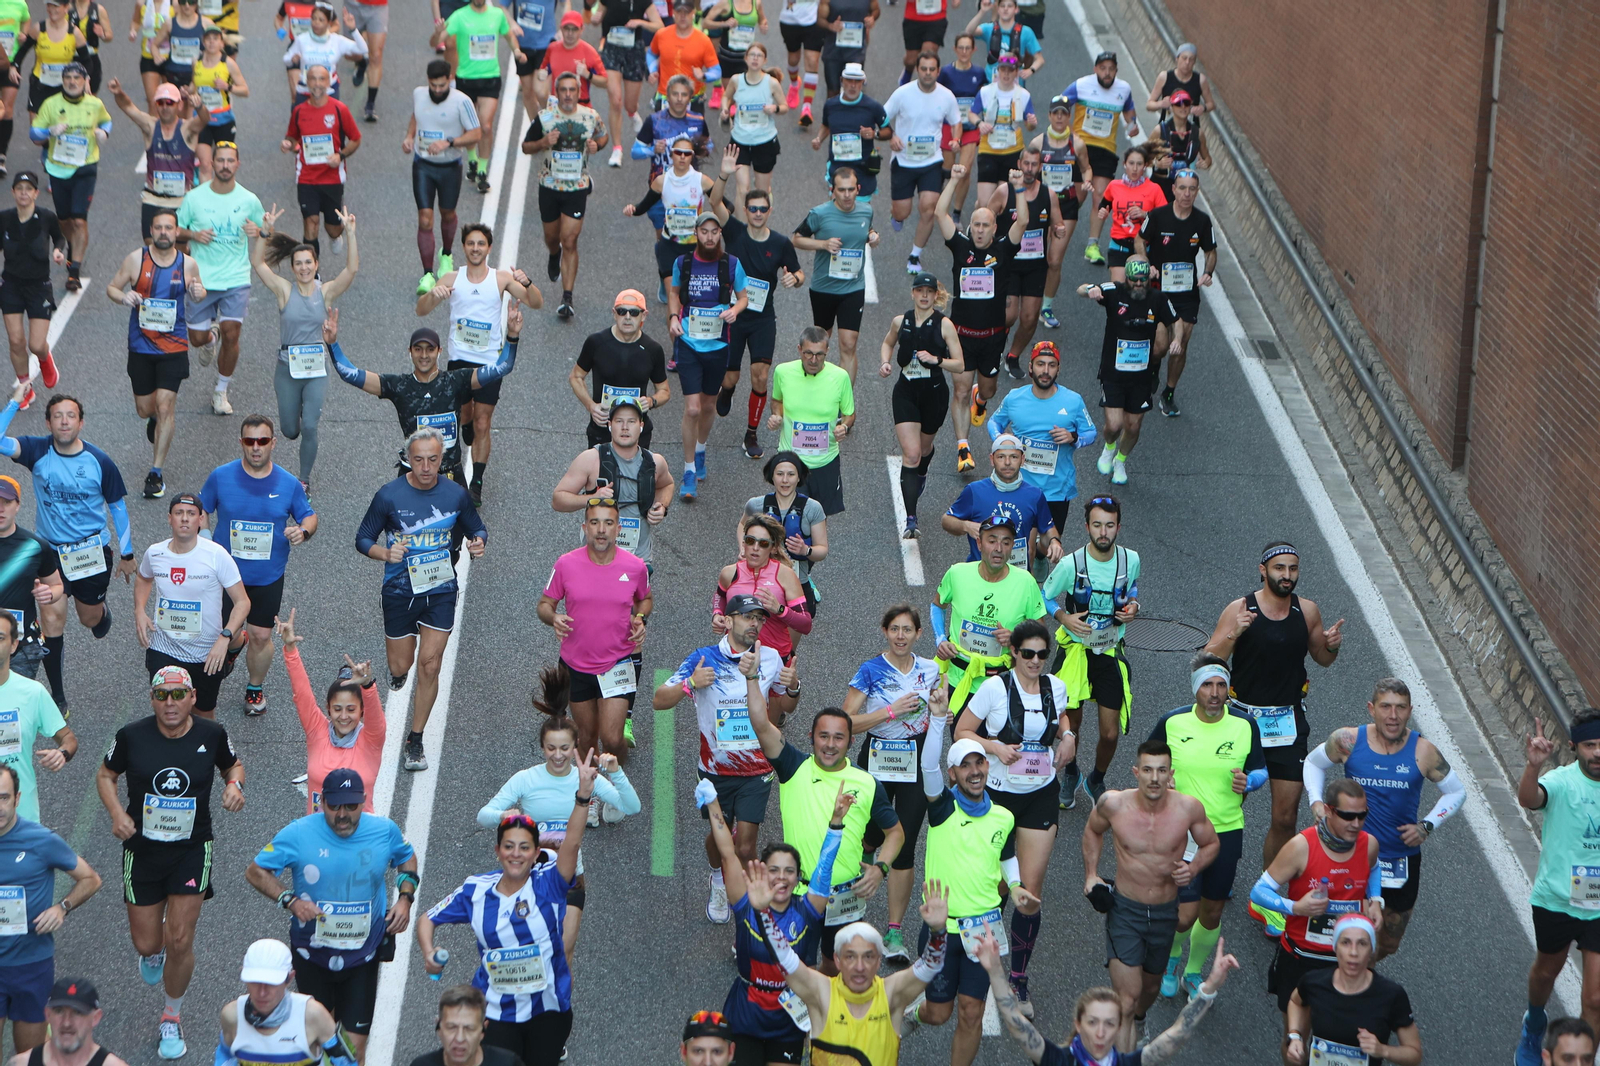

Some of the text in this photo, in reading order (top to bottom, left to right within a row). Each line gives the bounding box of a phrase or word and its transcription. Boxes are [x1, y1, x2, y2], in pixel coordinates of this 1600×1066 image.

[468, 320, 489, 329] ZURICH
[73, 540, 96, 550] ZURICH
[423, 552, 445, 562] ZURICH
[975, 627, 993, 635] ZURI
[885, 742, 910, 750] ZURICH
[1583, 842, 1600, 850] SEVI
[336, 906, 365, 914] ZURICH
[504, 949, 534, 959] ZURICH
[520, 974, 543, 982] CABEZA
[1331, 1046, 1361, 1057] ZURICH
